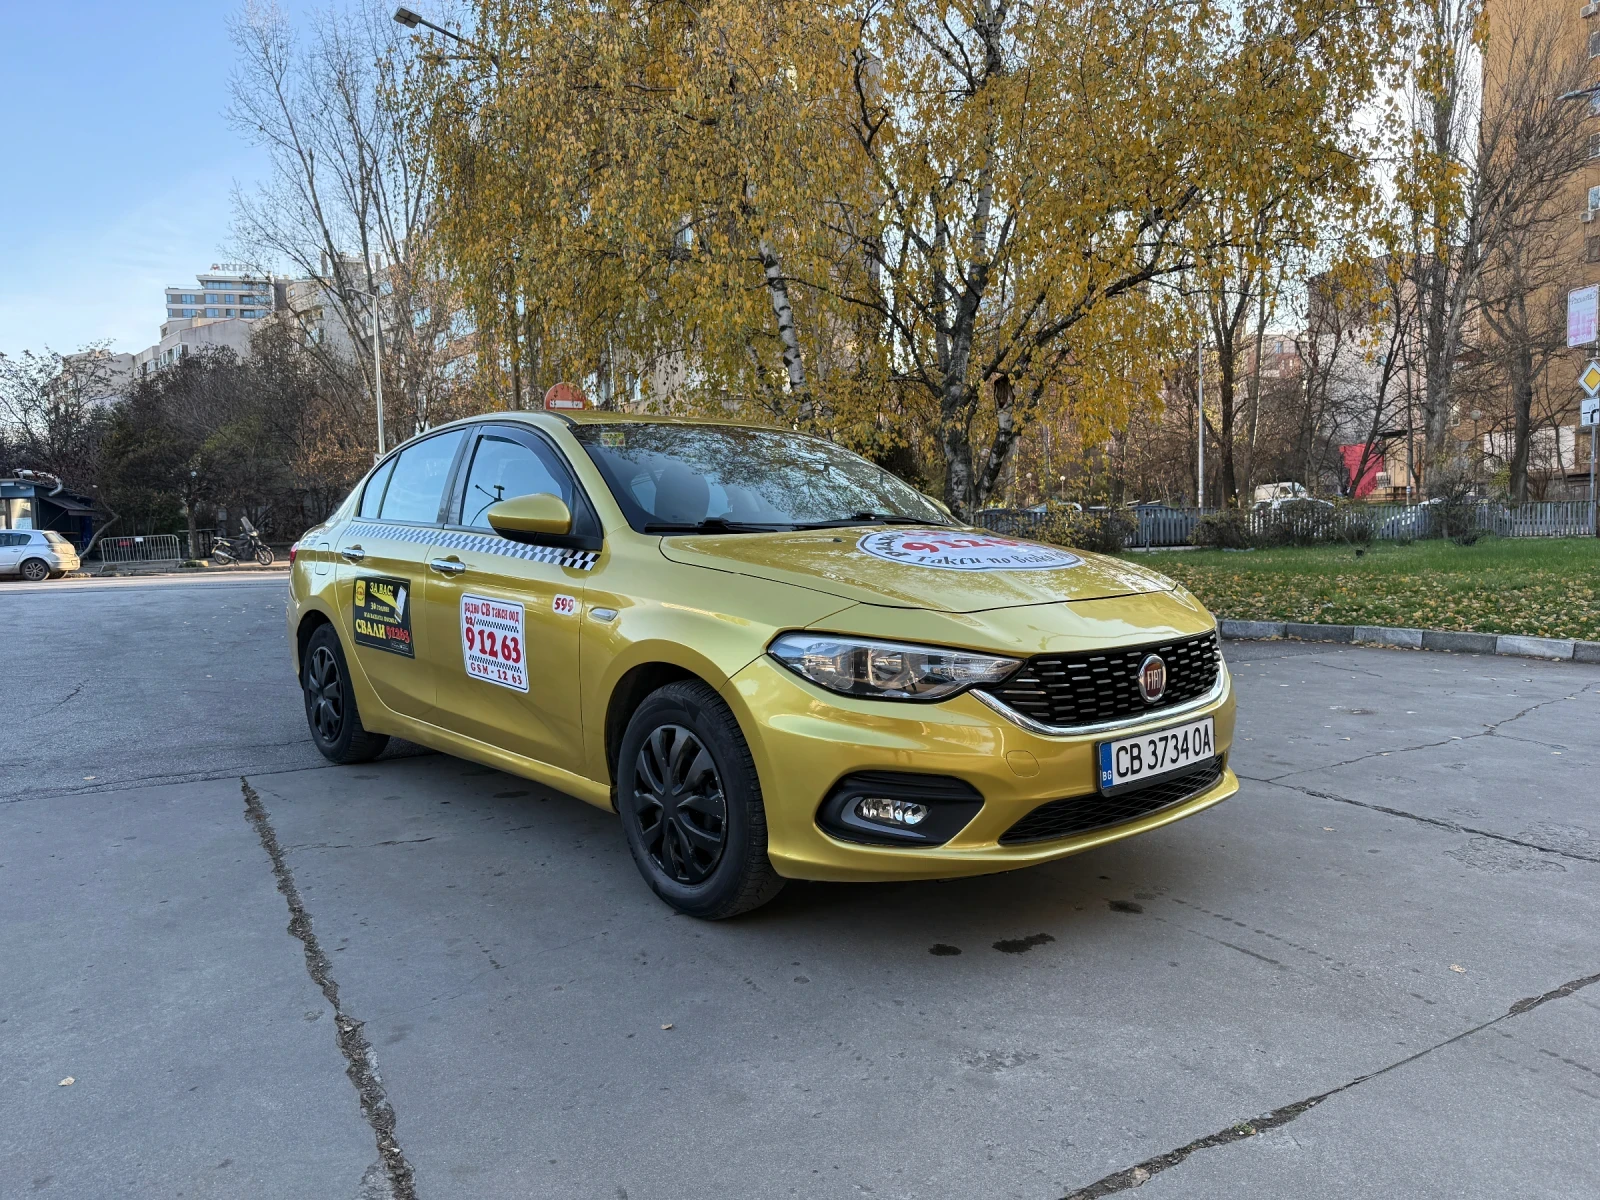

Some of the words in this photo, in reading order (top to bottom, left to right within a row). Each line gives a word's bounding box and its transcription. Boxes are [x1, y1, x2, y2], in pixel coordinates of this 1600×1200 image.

[369, 582, 378, 594] ЗА
[379, 582, 394, 596] ВАС!
[464, 602, 480, 615] радио
[481, 602, 491, 617] СВ
[491, 607, 508, 621] такси
[554, 597, 574, 612] 599
[355, 618, 386, 640] СВАЛИ
[386, 625, 410, 643] 91263
[470, 662, 489, 675] GSM
[1147, 669, 1162, 691] FIAT
[1147, 730, 1190, 770] 3734
[1102, 770, 1112, 780] BG
